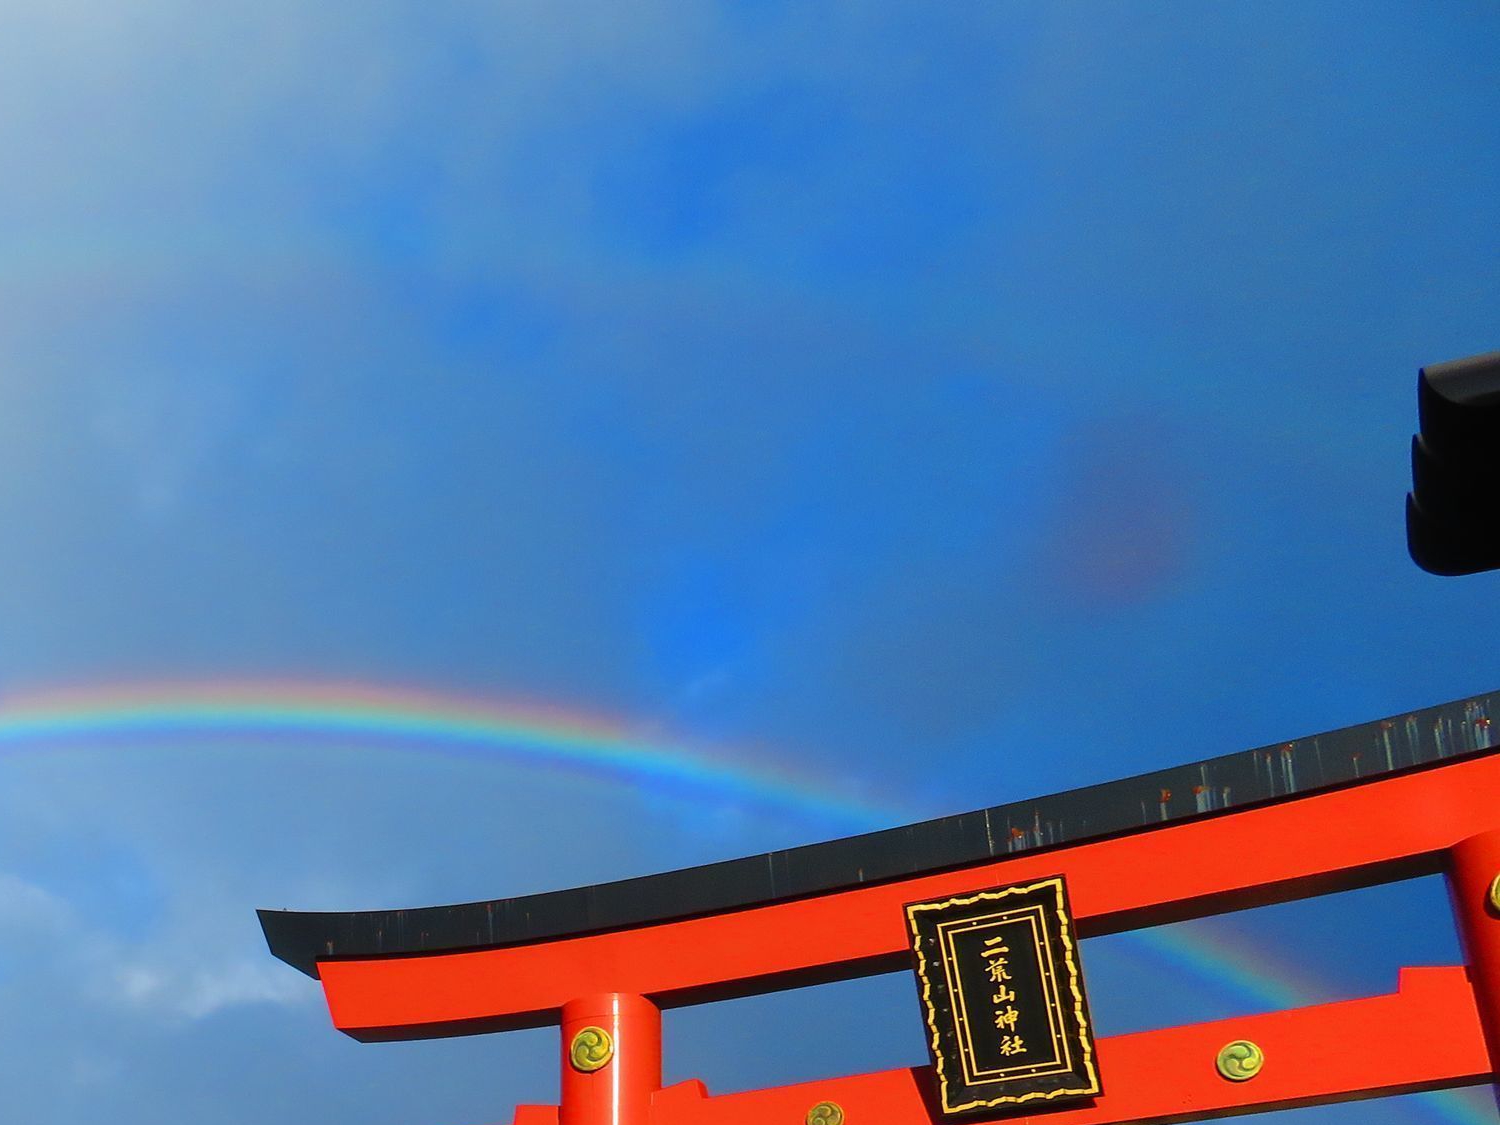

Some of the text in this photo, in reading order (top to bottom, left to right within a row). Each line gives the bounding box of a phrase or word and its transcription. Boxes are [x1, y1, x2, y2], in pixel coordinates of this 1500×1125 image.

[980, 936, 1027, 1057] 二荒山神社
